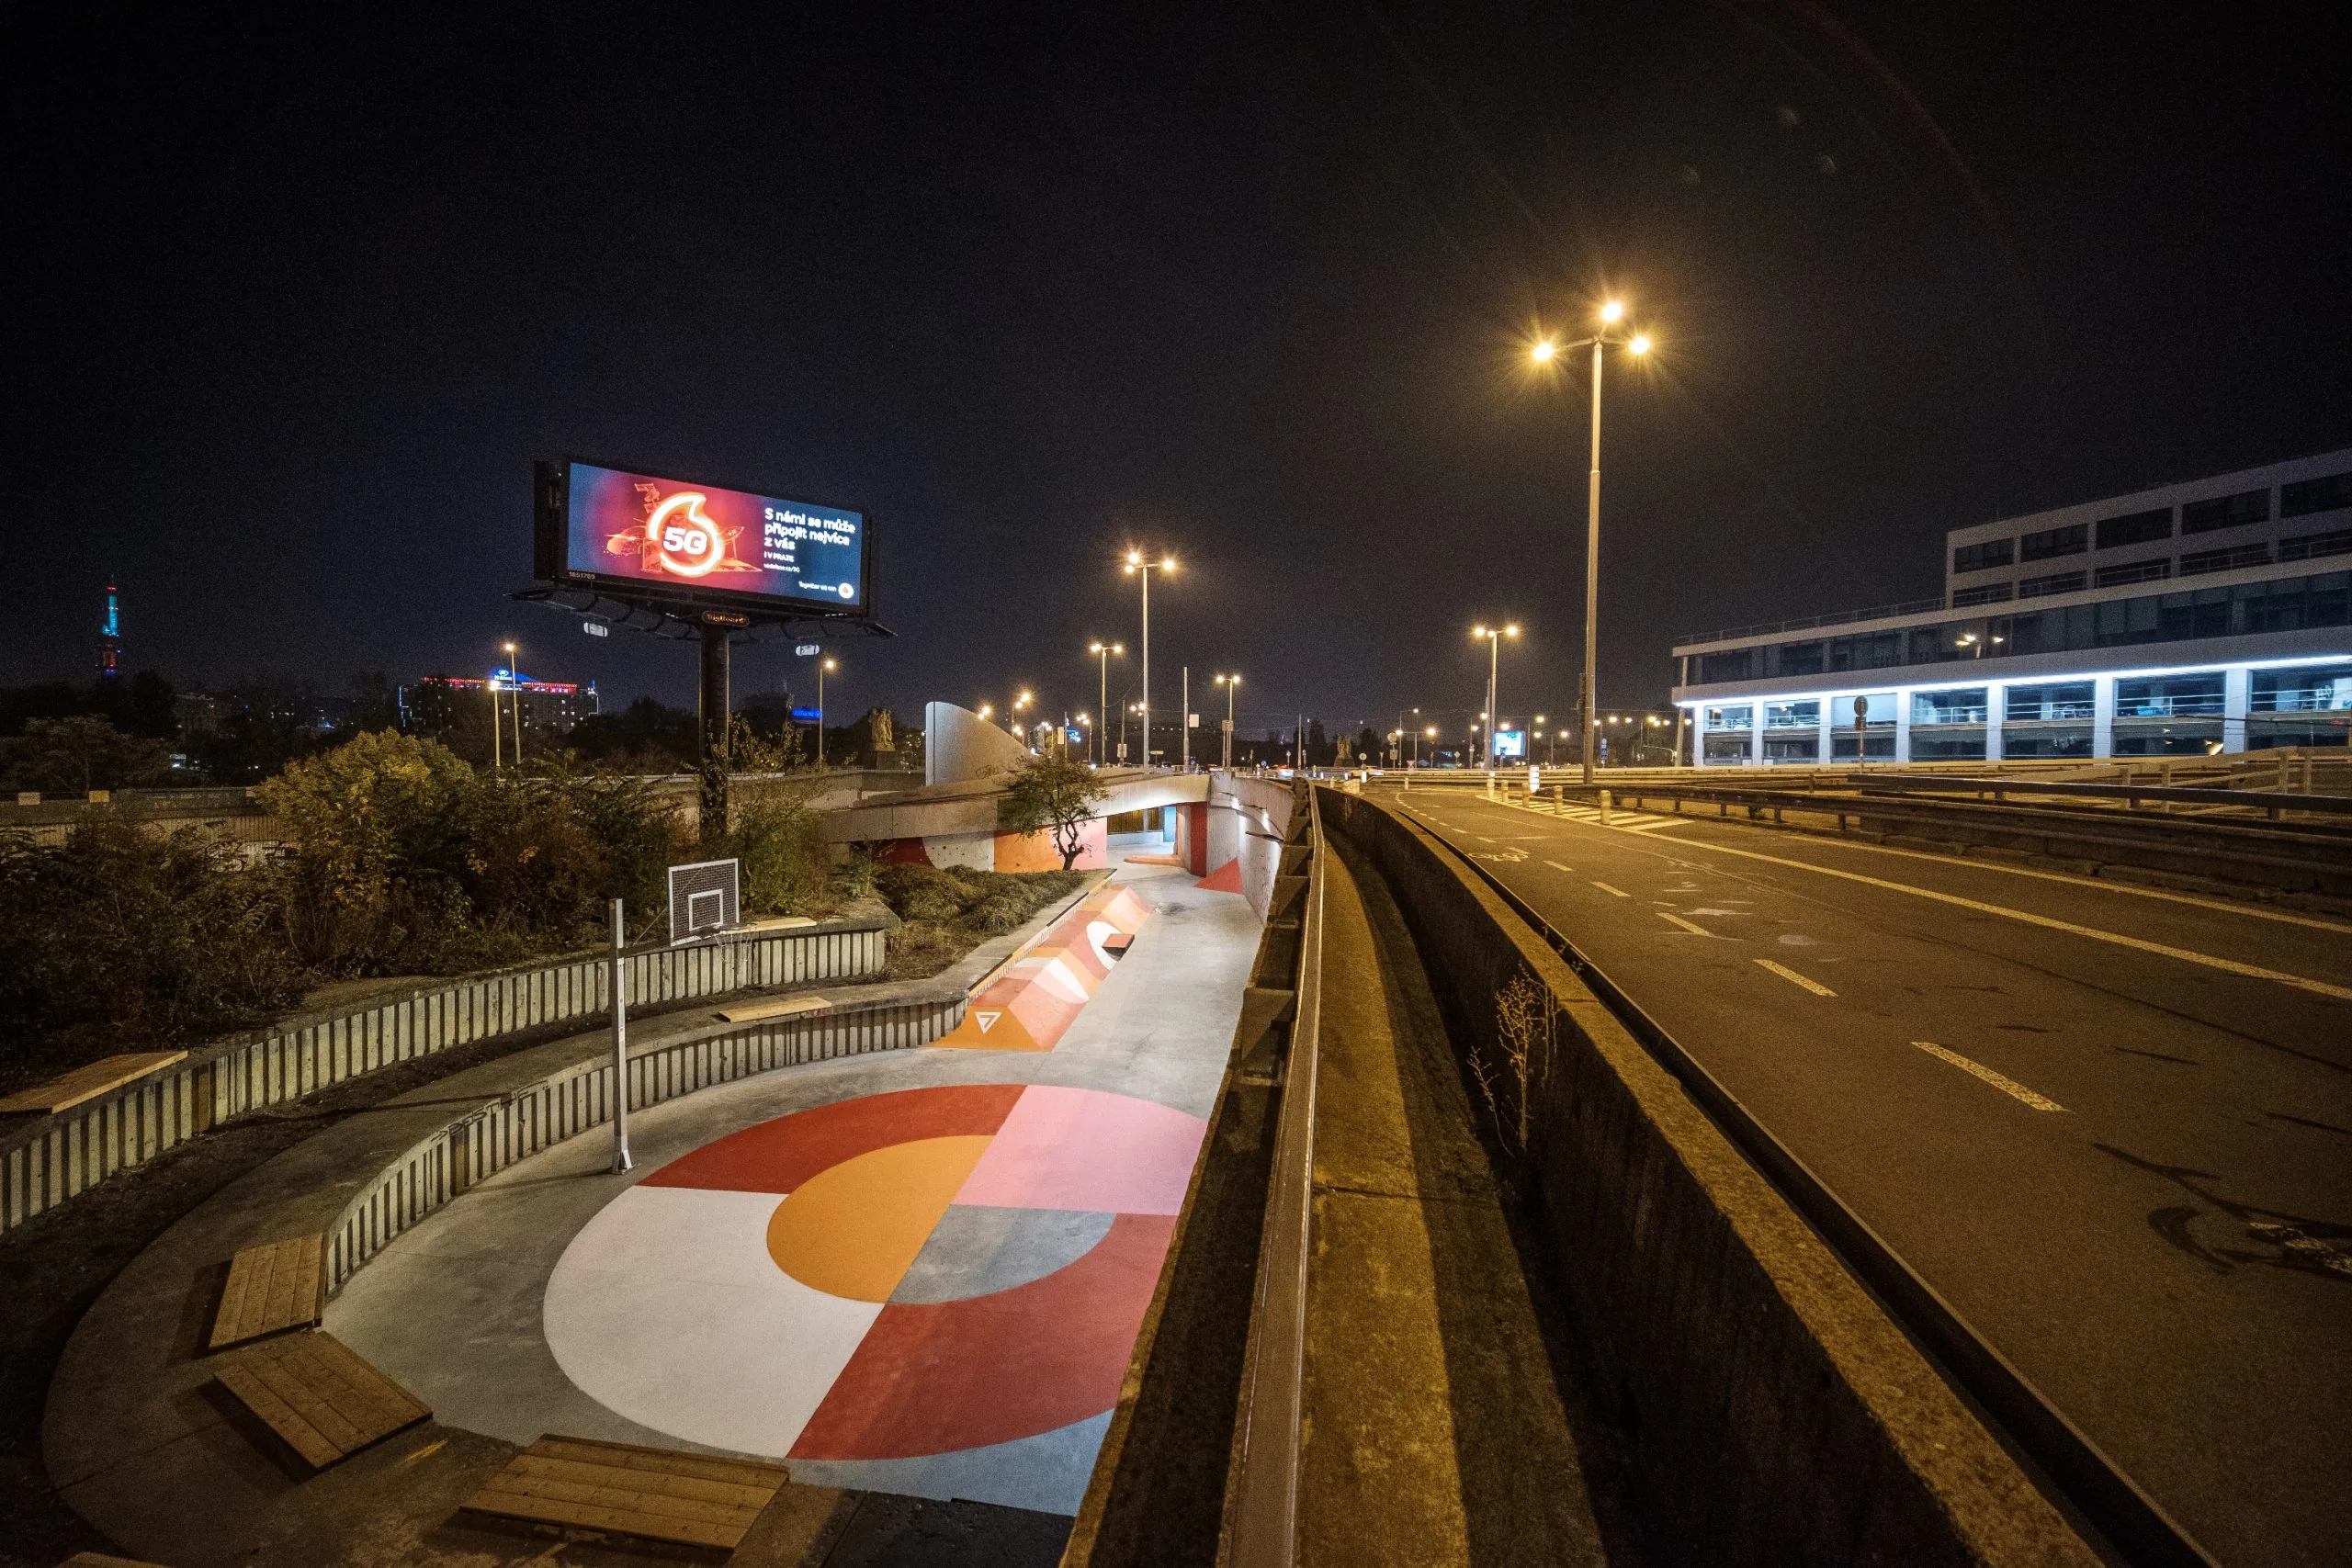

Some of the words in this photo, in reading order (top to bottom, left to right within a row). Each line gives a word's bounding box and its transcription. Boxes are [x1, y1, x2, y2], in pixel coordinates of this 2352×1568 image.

[764, 507, 774, 521] S
[808, 517, 821, 528] se
[823, 518, 856, 534] může
[662, 526, 708, 556] 5G
[763, 536, 773, 547] z
[774, 537, 796, 550] vás
